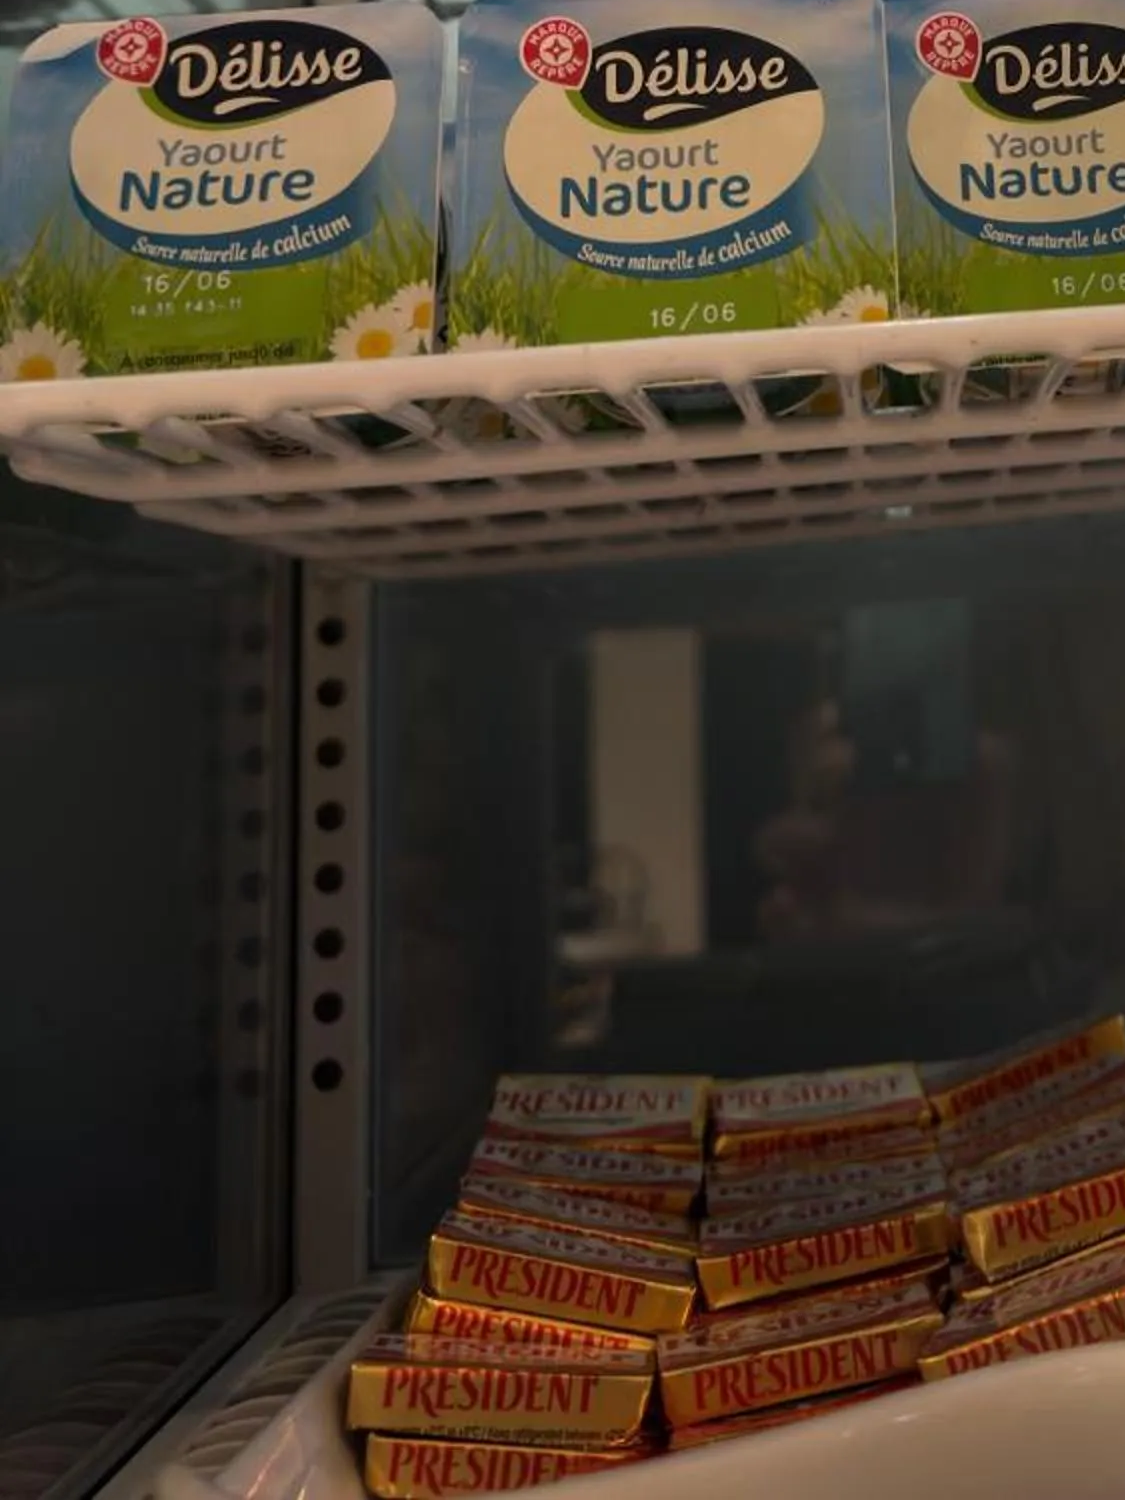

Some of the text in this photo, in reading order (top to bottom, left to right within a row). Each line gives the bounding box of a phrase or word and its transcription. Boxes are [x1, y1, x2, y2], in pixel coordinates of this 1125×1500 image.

[169, 40, 362, 99] Délisse
[595, 48, 789, 104] Délisse
[158, 133, 288, 168] Yaourt
[592, 138, 720, 173] Yaourt
[987, 128, 1105, 160] Yaourt
[119, 168, 316, 213] Nature
[560, 172, 751, 219] Nature
[131, 213, 352, 263] Source naturelle de calcium
[577, 220, 792, 271] Source naturelle de calcium
[979, 222, 1026, 249] Source
[1027, 229, 1090, 250] naturelle
[1093, 224, 1109, 246] de
[729, 1213, 917, 1287] PRESIDENT
[449, 1245, 646, 1319] PRESIDENT
[383, 1367, 600, 1419] PRESIDENT
